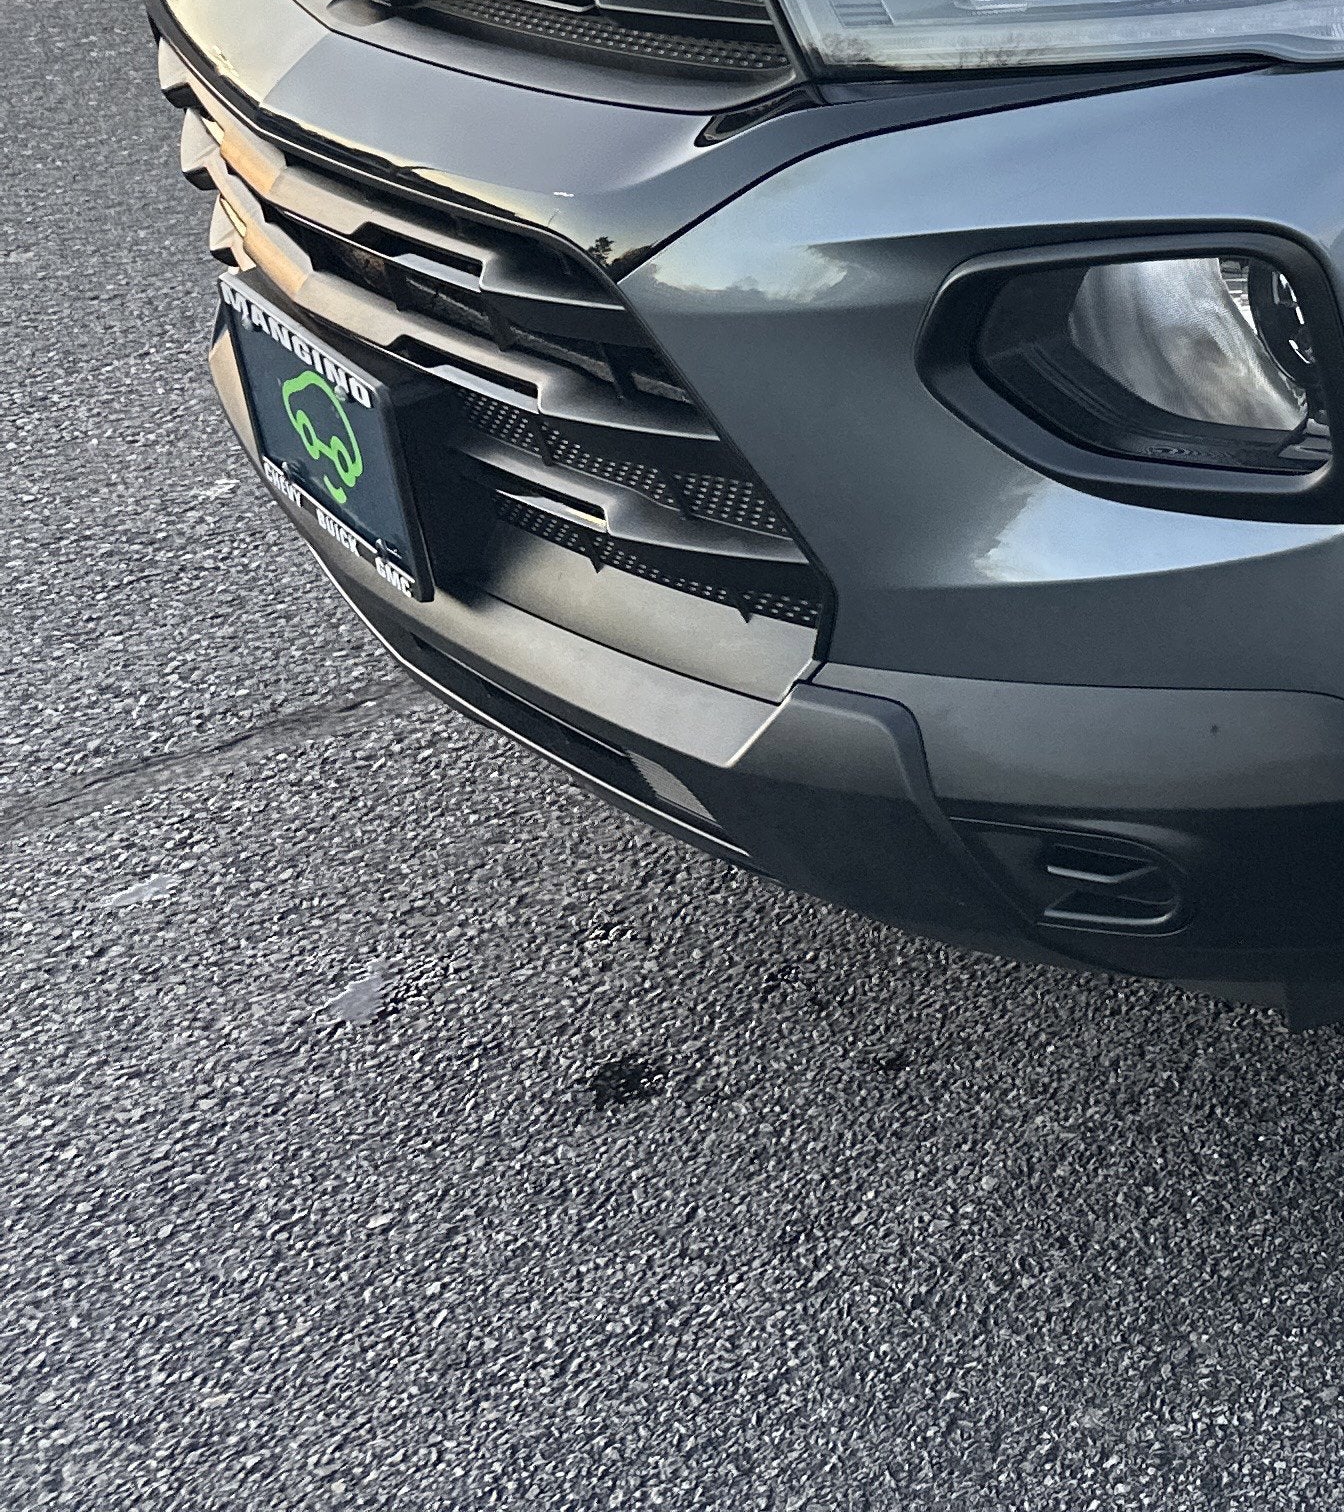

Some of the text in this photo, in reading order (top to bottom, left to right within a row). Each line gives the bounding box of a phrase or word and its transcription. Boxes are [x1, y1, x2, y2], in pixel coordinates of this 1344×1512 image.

[220, 281, 372, 409] MANCINO
[263, 461, 413, 598] CHEVY BUICK GMC
